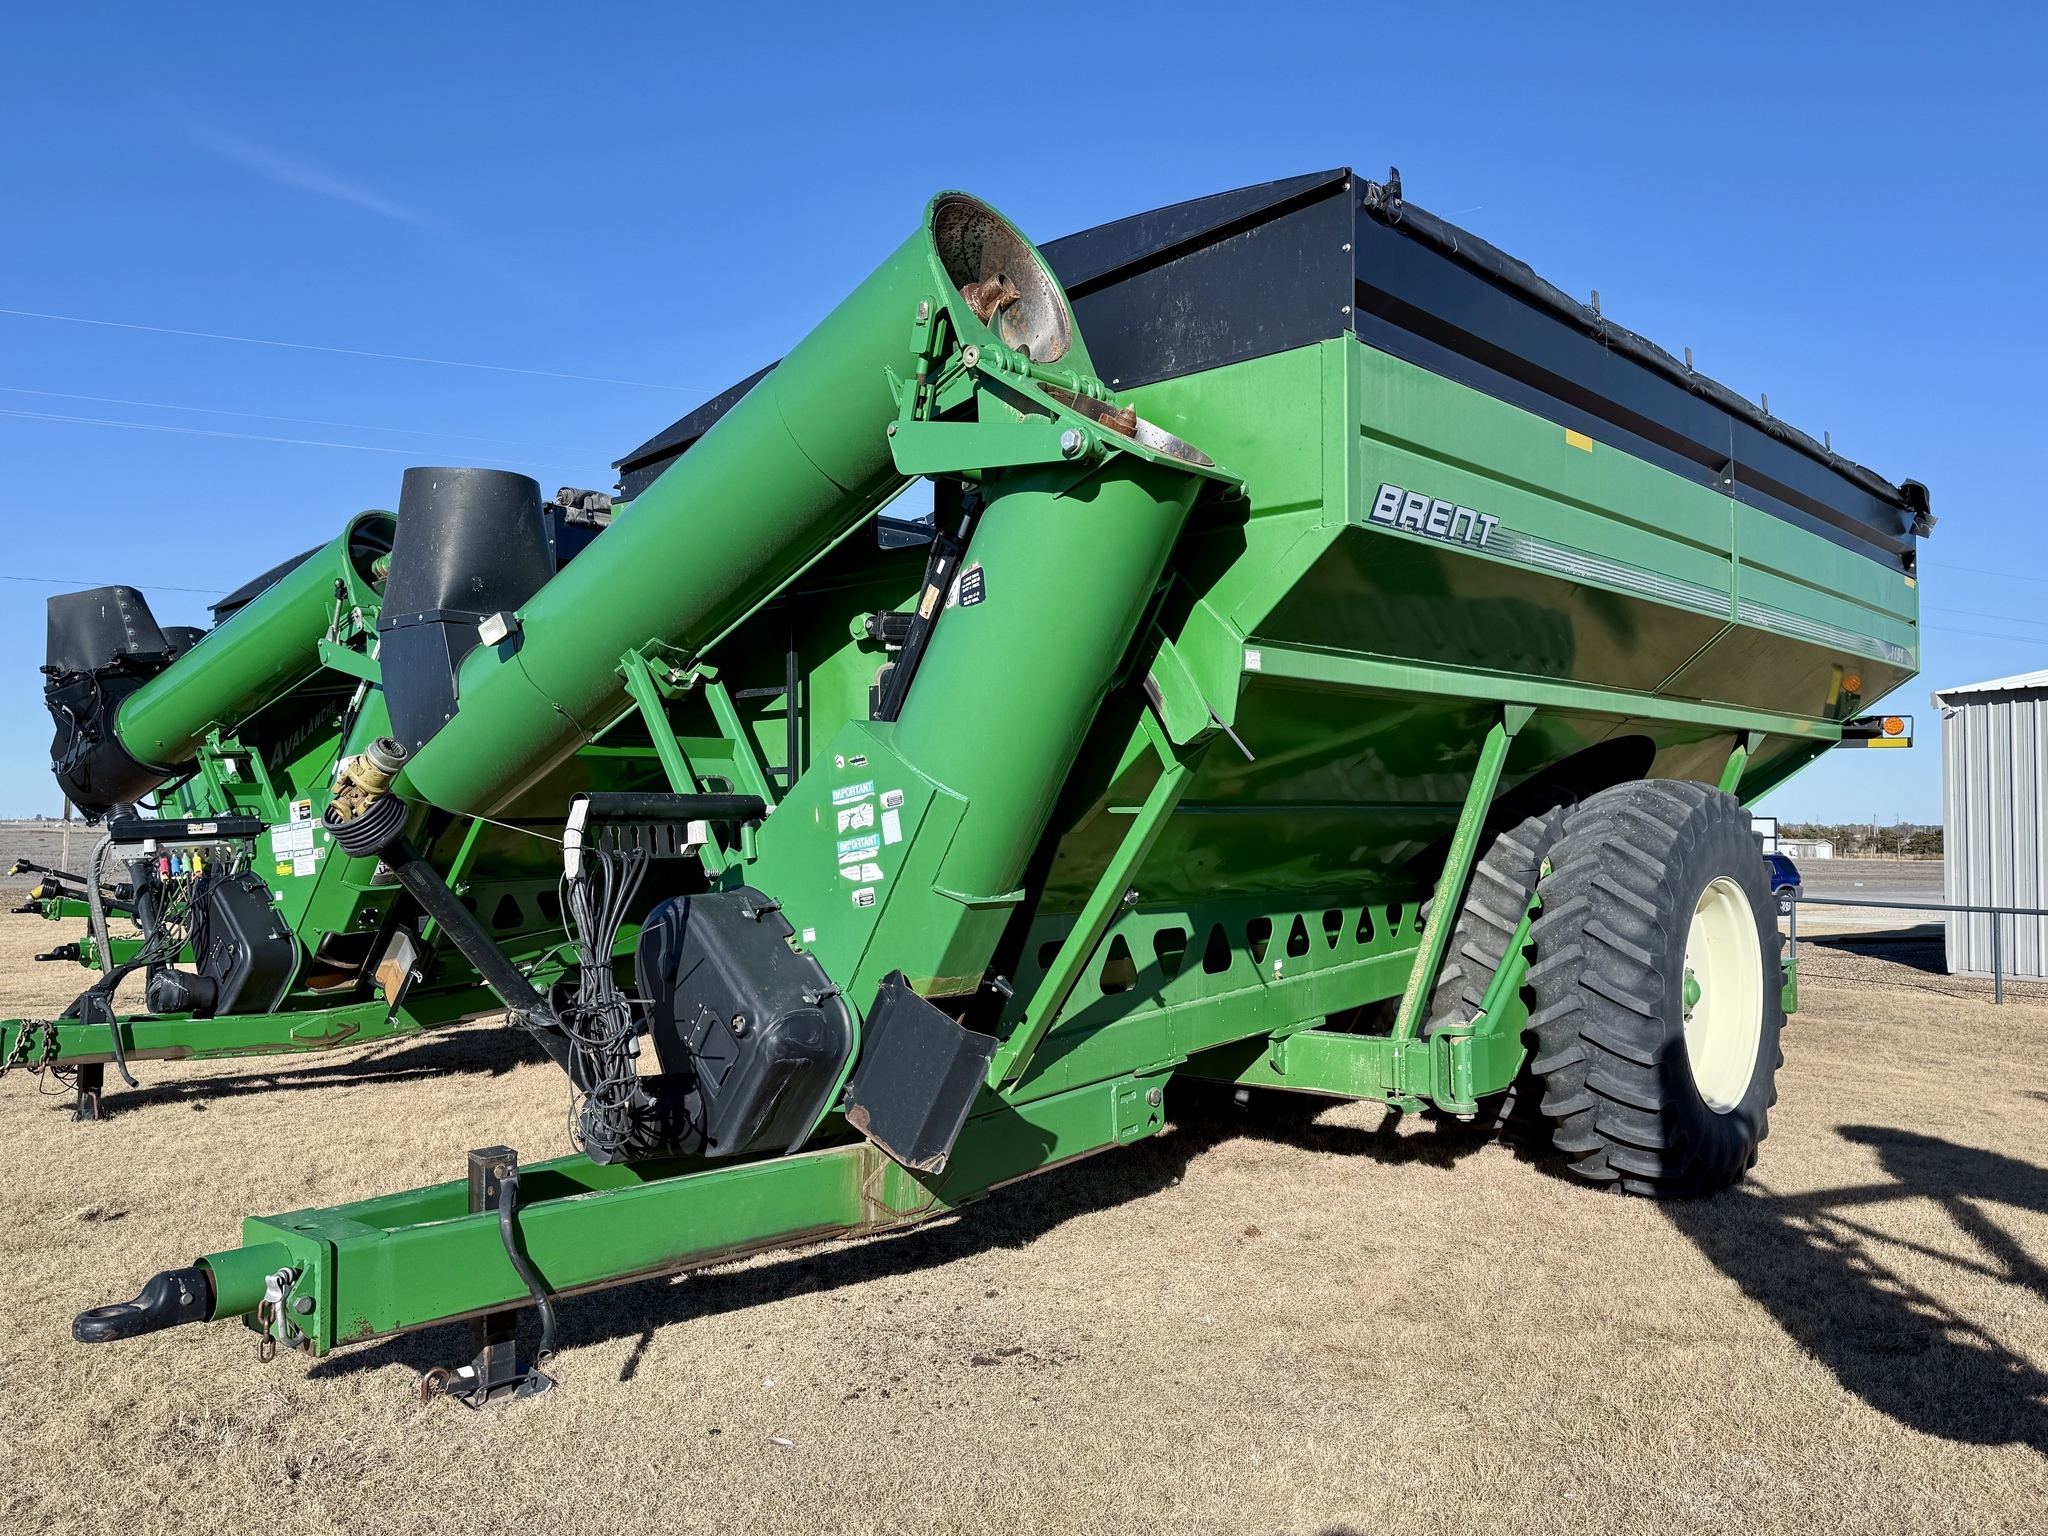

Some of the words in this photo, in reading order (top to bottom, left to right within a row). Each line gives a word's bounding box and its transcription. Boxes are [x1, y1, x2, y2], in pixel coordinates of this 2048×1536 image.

[1370, 482, 1500, 547] BRENT
[269, 700, 336, 772] AVALANCHE
[834, 781, 873, 800] IMPORTANT
[839, 834, 878, 852] IMPORTANT
